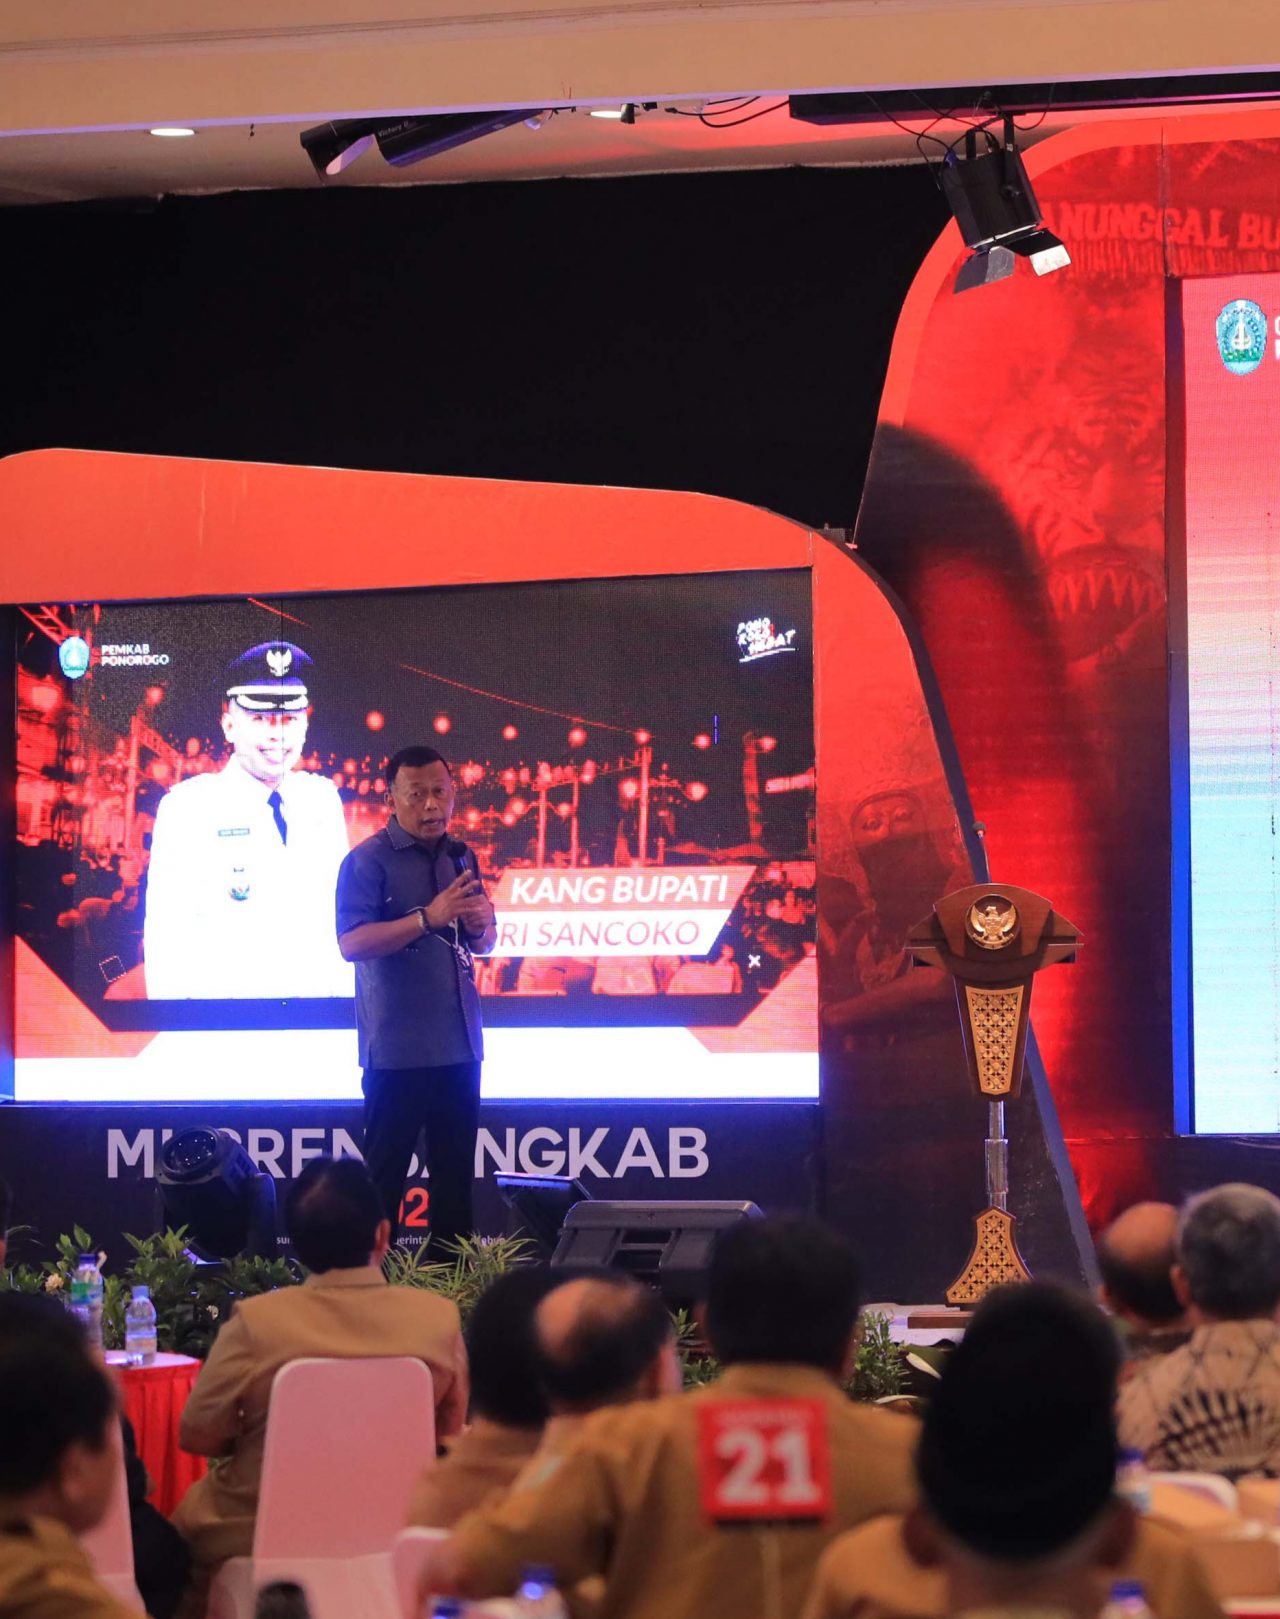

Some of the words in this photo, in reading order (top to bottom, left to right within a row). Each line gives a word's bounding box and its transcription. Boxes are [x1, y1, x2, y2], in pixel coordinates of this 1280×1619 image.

[102, 644, 150, 655] PEMKAB
[102, 654, 169, 667] PONOROGO
[510, 876, 606, 904] KANG
[612, 875, 728, 904] BUPATI
[535, 920, 700, 947] SANCOKO
[715, 1430, 822, 1505] 21
